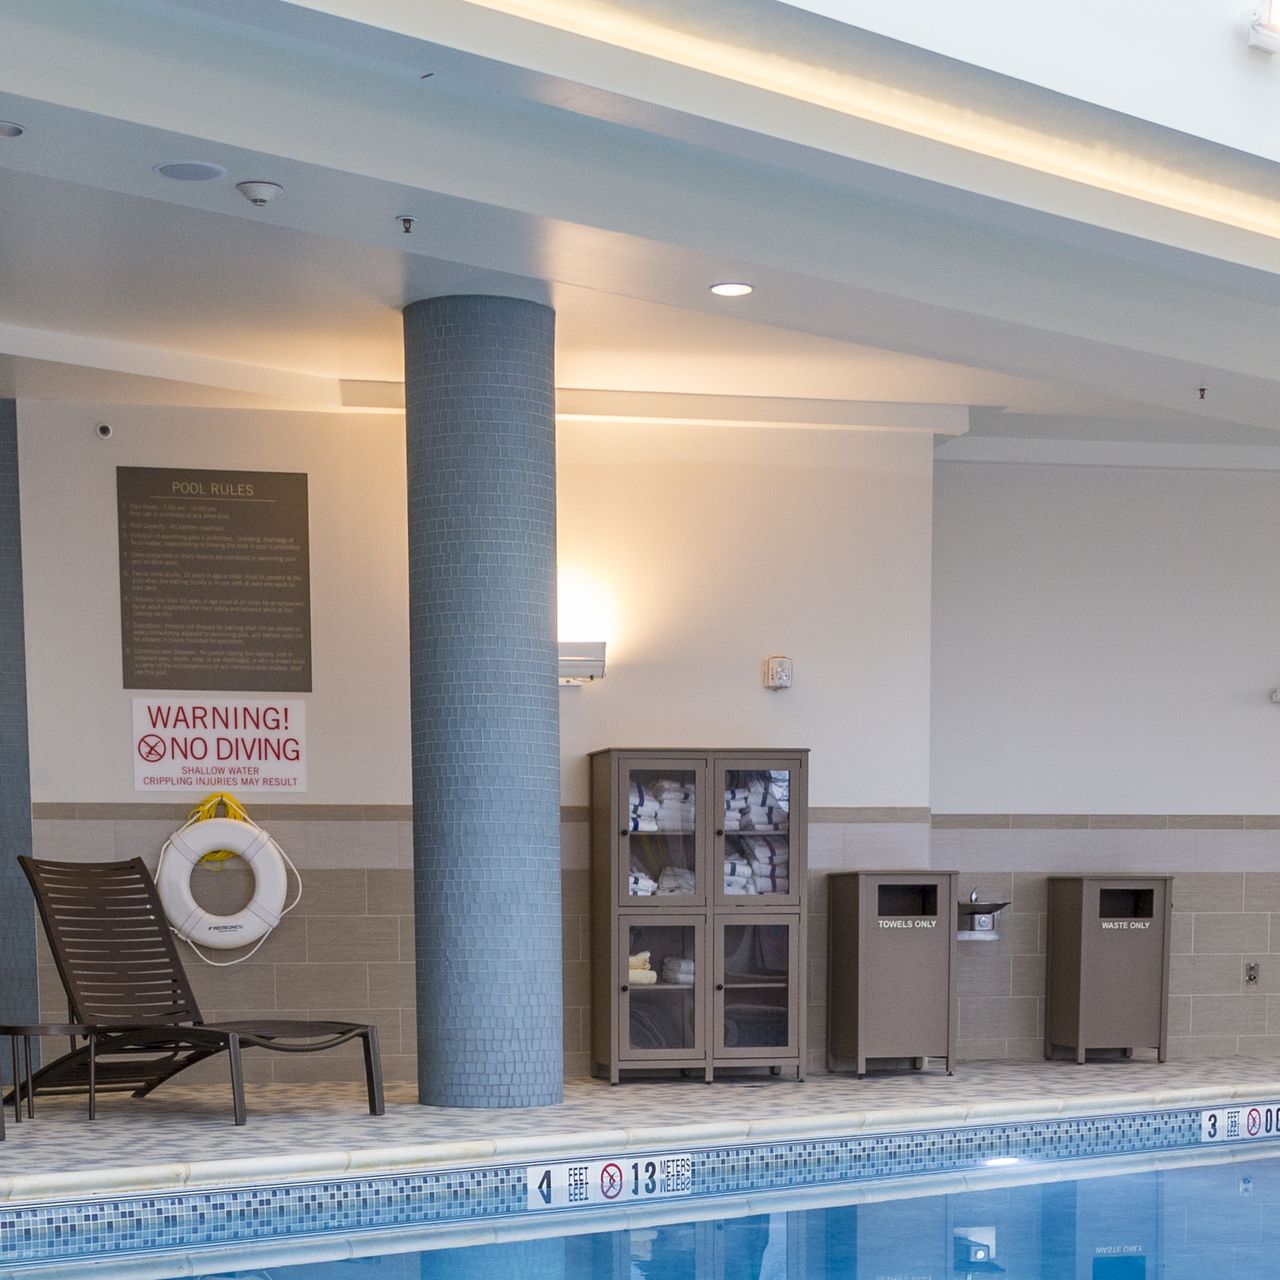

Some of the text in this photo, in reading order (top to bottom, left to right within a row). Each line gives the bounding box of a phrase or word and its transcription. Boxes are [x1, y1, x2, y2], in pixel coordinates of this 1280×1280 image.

[172, 481, 255, 497] POOL RULES
[147, 705, 289, 731] WARNING!
[171, 737, 300, 761] NO DIVING
[181, 766, 260, 775] SHALLOW WATER
[143, 776, 298, 787] CRIPPLING INJURIES MAY RESULT
[878, 920, 937, 928] TOWELS ONLY
[1101, 921, 1150, 929] WASTE ONLY
[568, 1166, 589, 1183] FEET
[660, 1158, 691, 1174] METERS
